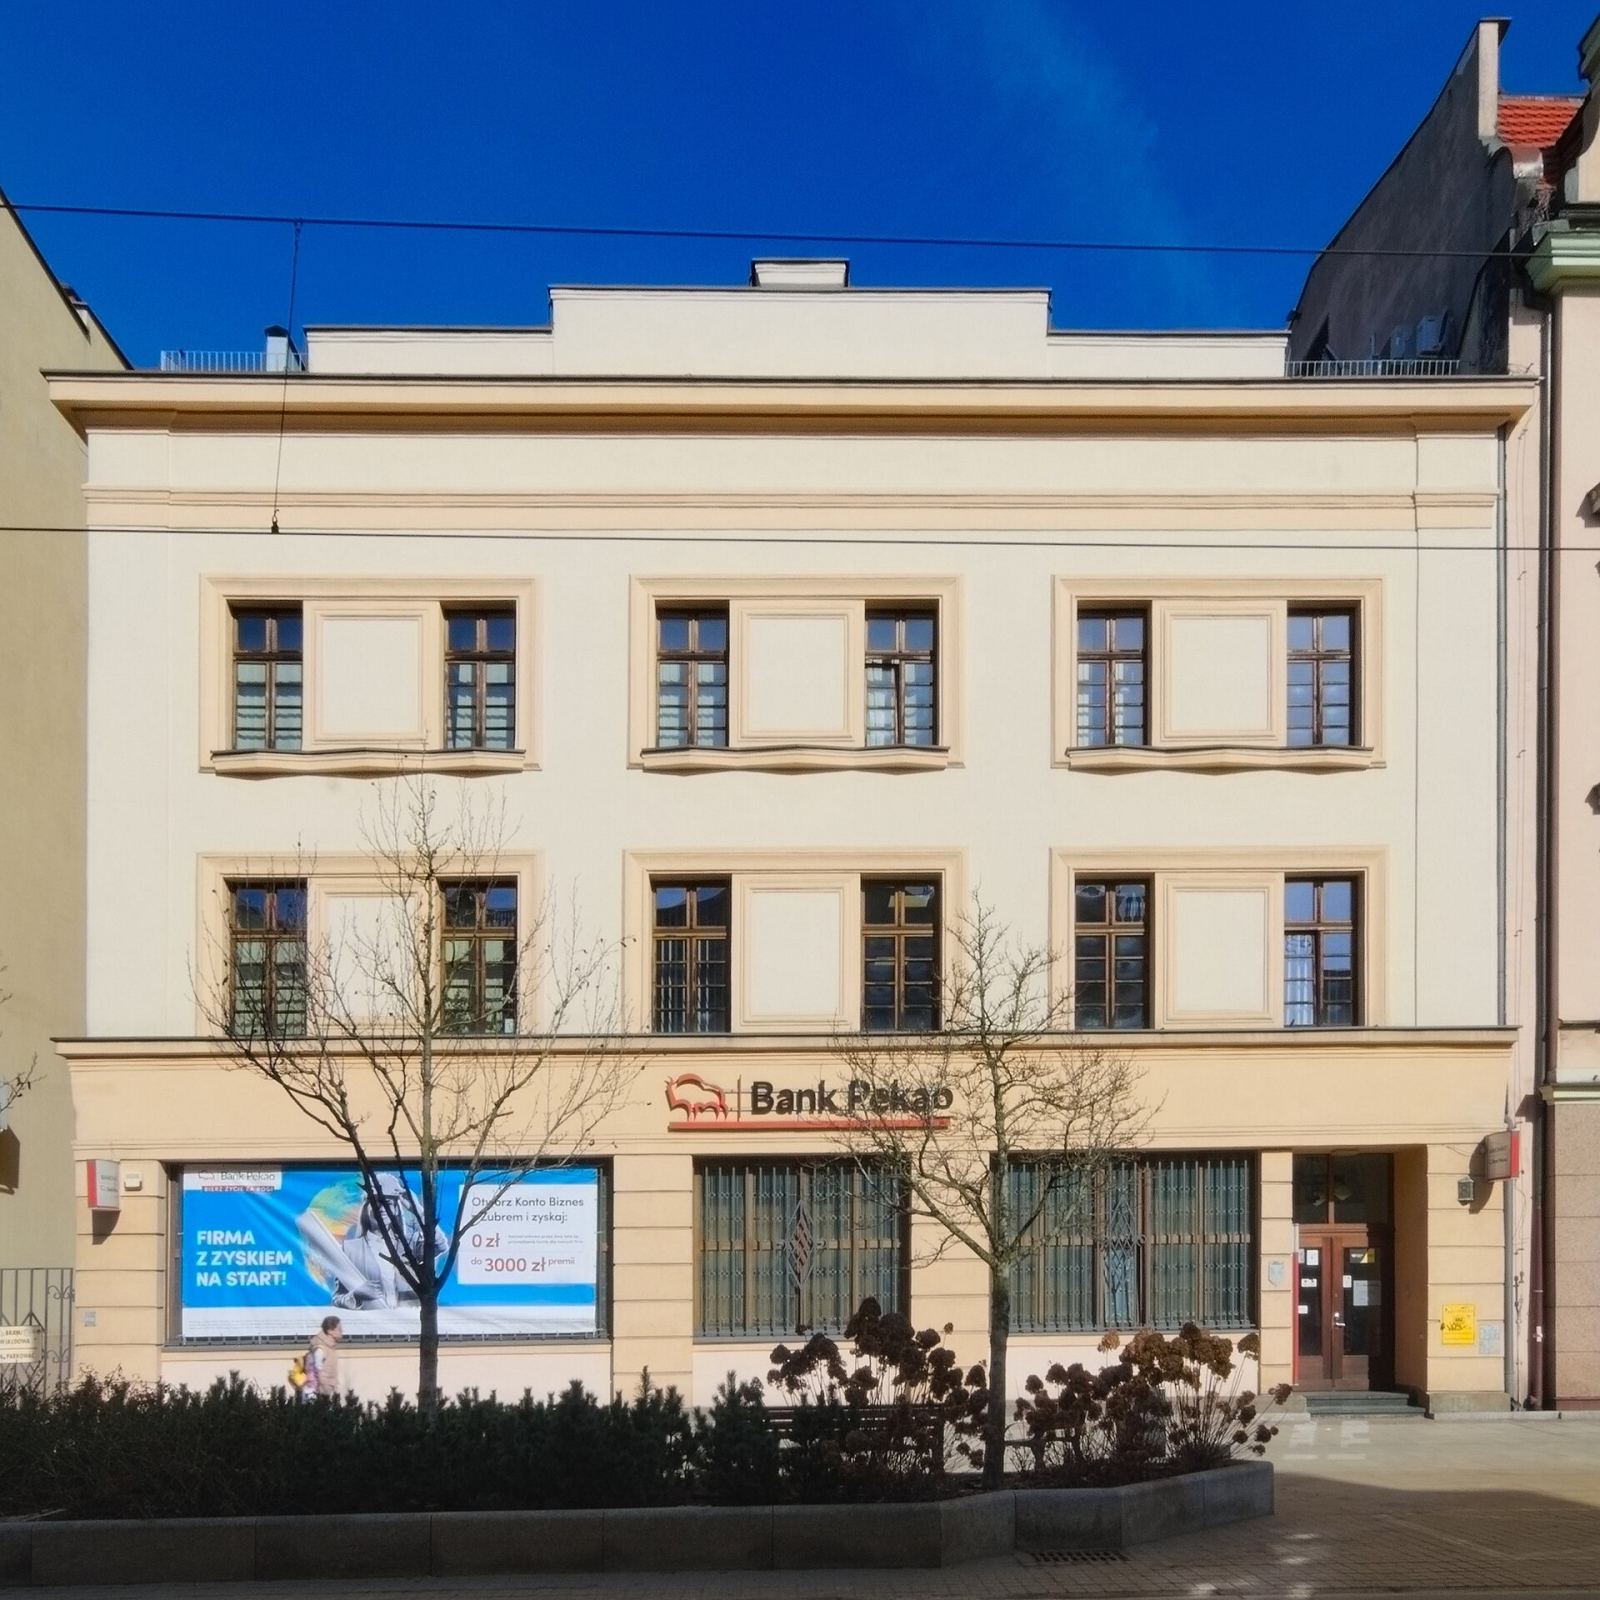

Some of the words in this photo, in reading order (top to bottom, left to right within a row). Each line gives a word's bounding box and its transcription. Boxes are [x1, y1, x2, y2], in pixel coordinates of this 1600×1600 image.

[750, 1080, 838, 1116] Bank
[848, 1079, 954, 1114] Pekao
[220, 1170, 243, 1181] Bank
[246, 1170, 276, 1181] Pekao
[471, 1196, 512, 1207] Otórz
[515, 1196, 546, 1207] Konto
[549, 1196, 584, 1207] Biznes
[532, 1212, 568, 1224] zyskaj:
[196, 1230, 256, 1246] FIRMA
[472, 1233, 482, 1248] 0
[486, 1232, 500, 1248] zł
[196, 1251, 208, 1266] Z
[210, 1250, 294, 1266] ZYSKIEM
[470, 1257, 482, 1266] do
[484, 1258, 527, 1272] 3000
[531, 1256, 546, 1272] zł
[548, 1257, 576, 1267] premii
[196, 1272, 222, 1287] NA
[226, 1271, 287, 1287] START!
